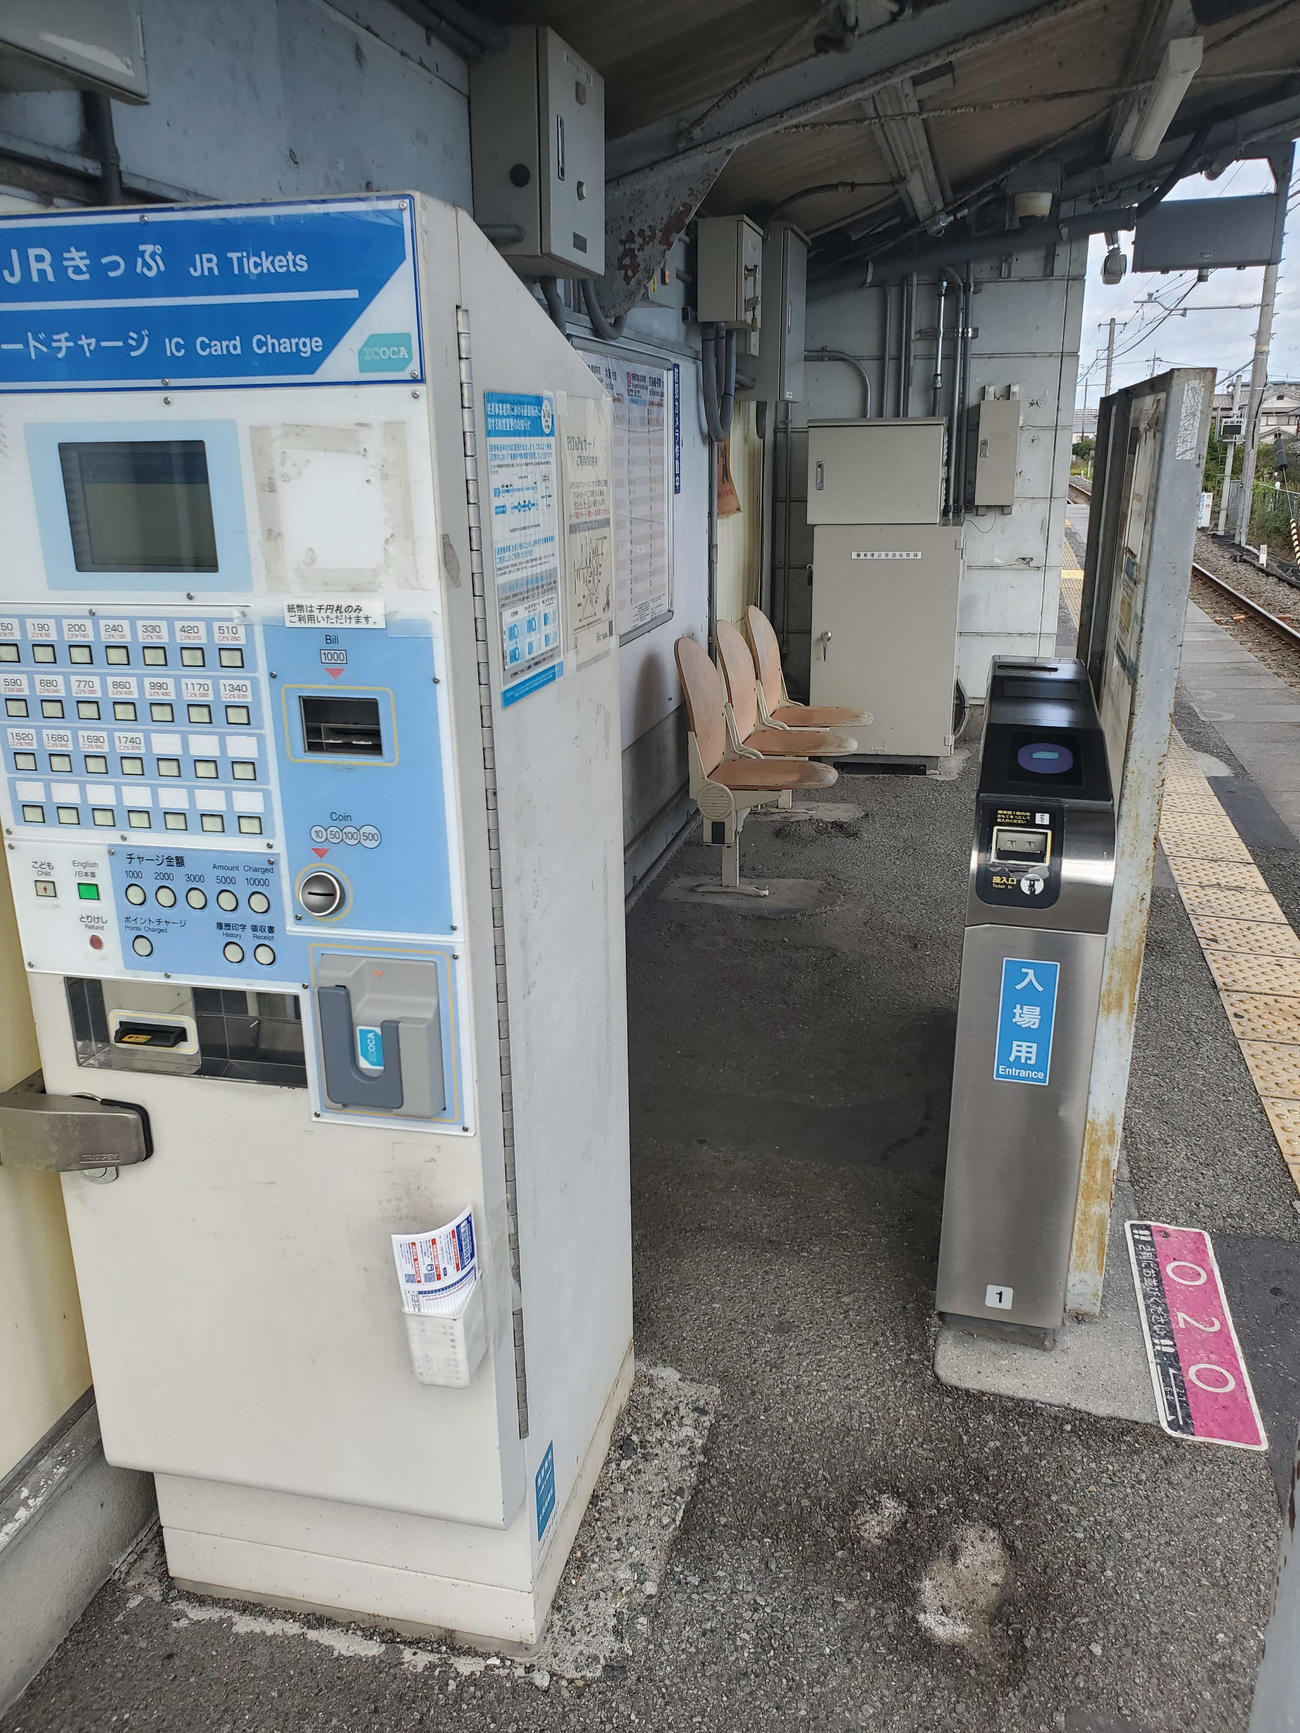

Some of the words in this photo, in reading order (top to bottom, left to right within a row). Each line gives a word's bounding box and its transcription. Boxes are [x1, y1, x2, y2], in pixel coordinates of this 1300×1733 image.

[3, 244, 165, 284] JRきっぷ
[189, 253, 219, 277] JR
[227, 251, 309, 275] Tickets
[165, 337, 185, 357] IC
[196, 336, 242, 356] Card
[252, 334, 323, 357] Charge
[287, 604, 363, 614] 紙幣は千円札のみ
[289, 615, 378, 625] ご利用いただけます。
[325, 635, 340, 645] Bill
[323, 652, 345, 662] 1000
[330, 812, 353, 821] Coin
[314, 829, 324, 839] 10
[329, 831, 341, 840] 50
[343, 831, 359, 841] 100
[362, 832, 380, 842] 500
[32, 861, 54, 870] こども
[72, 860, 99, 869] English
[126, 853, 185, 868] チャージ金額
[213, 863, 240, 872] Amount
[243, 864, 275, 874] Charged
[125, 870, 143, 879] 1000
[154, 871, 175, 881] 2000
[185, 873, 206, 883] 3000
[216, 875, 237, 885] 5000
[246, 877, 271, 887] 10000
[80, 915, 108, 925] とりけし
[124, 916, 188, 928] ポイントチャージ
[222, 932, 243, 940] History
[1009, 968, 1045, 1065] 入場用
[998, 1065, 1045, 1080] Entrance
[995, 1291, 1003, 1304] 1
